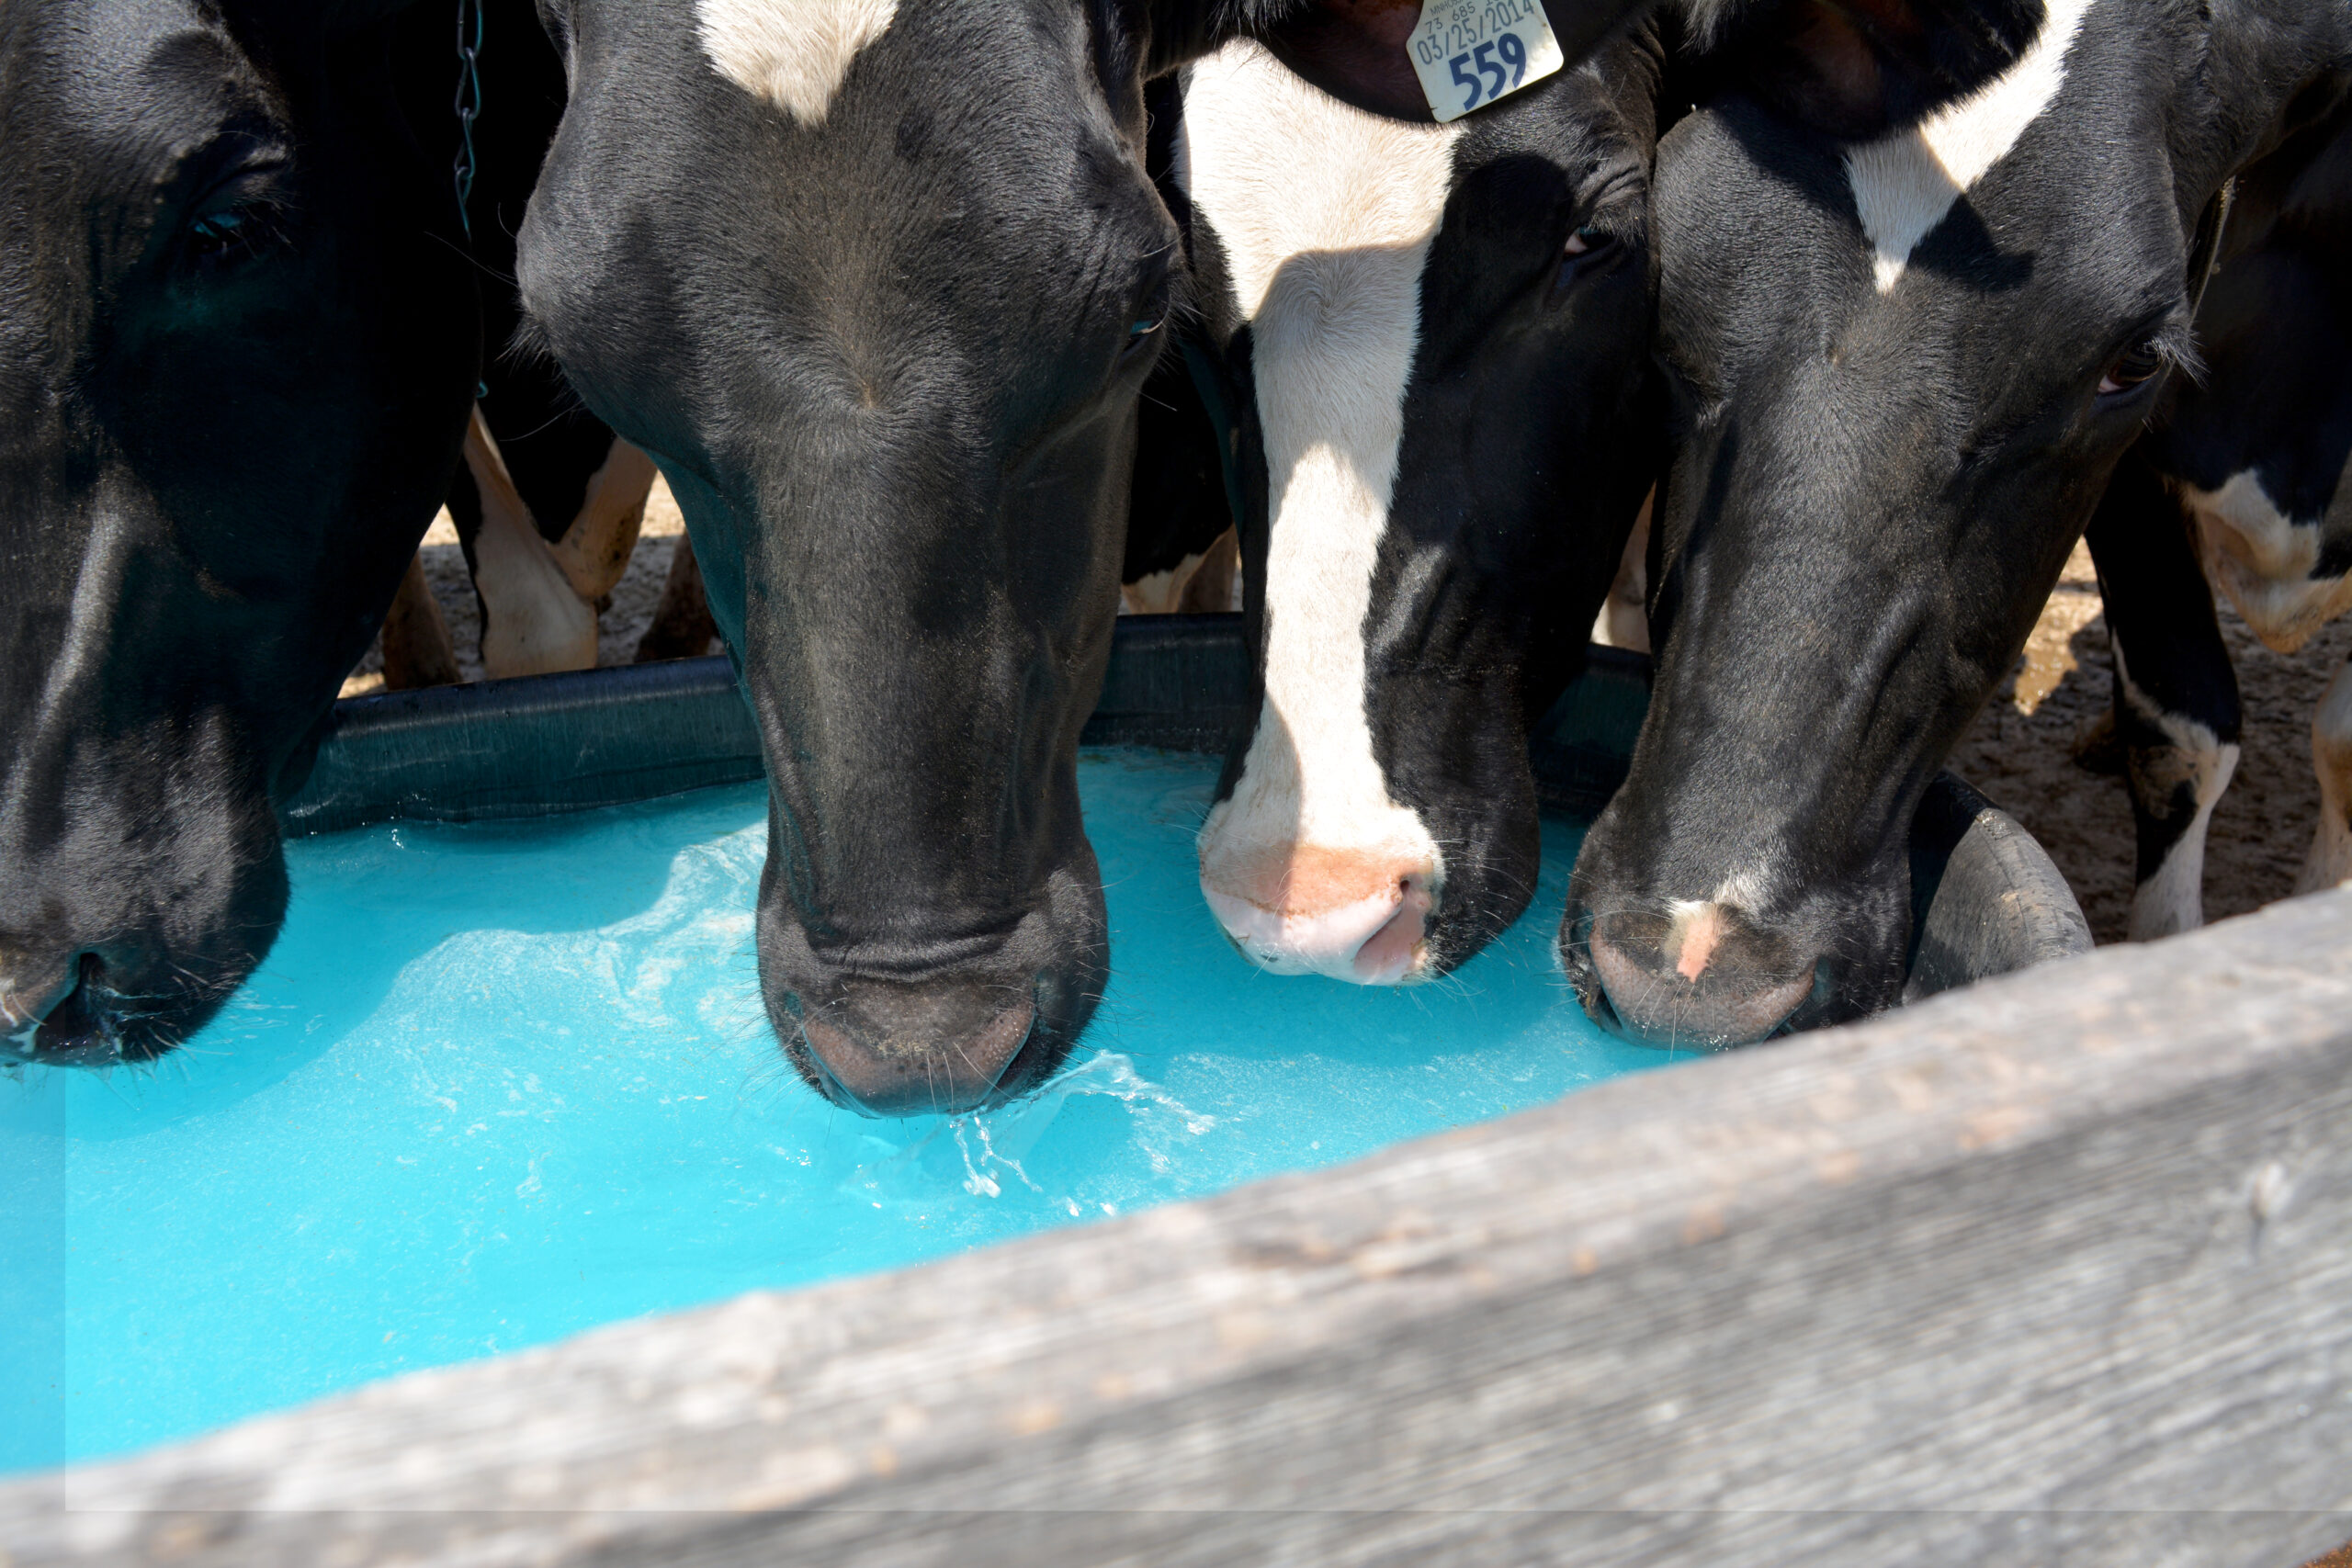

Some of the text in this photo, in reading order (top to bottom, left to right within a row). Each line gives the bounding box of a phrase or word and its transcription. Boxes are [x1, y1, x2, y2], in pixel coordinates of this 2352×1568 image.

[1417, 0, 1534, 65] 03/25/2014
[1425, 2, 1476, 34] 73 685
[1448, 32, 1526, 111] 559
